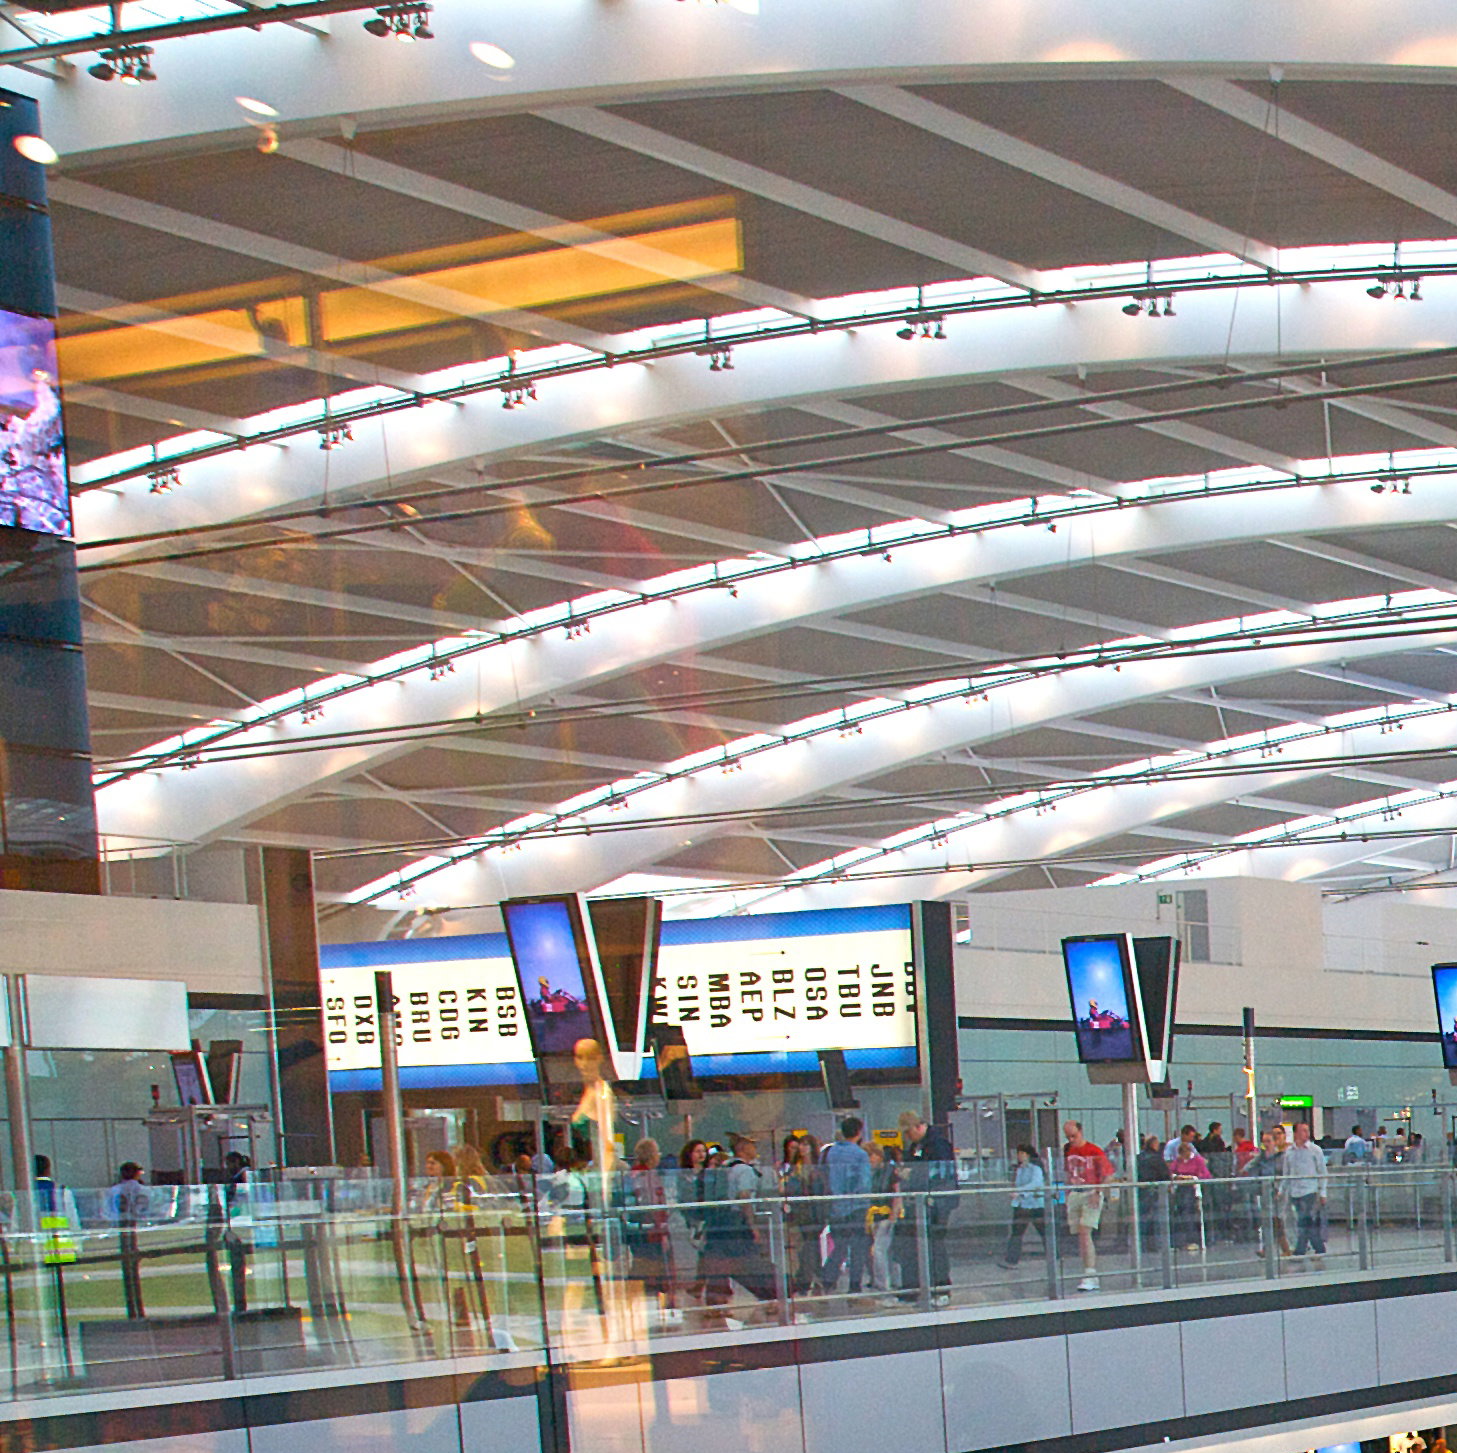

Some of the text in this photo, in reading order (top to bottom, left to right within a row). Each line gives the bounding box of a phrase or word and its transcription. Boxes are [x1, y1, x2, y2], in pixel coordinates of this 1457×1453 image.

[438, 990, 460, 1040] CDG
[466, 988, 488, 1033] KIN
[496, 986, 518, 1037] BSB
[677, 975, 700, 1021] SIN
[708, 973, 732, 1028] MBA
[740, 971, 764, 1022] AEP
[772, 969, 796, 1020] BLZ
[804, 967, 828, 1020] OSA
[837, 964, 861, 1018] TBU
[870, 963, 895, 1017] JNB
[326, 997, 347, 1044] SFO
[354, 995, 375, 1044] DXB
[410, 992, 431, 1042] BRU
